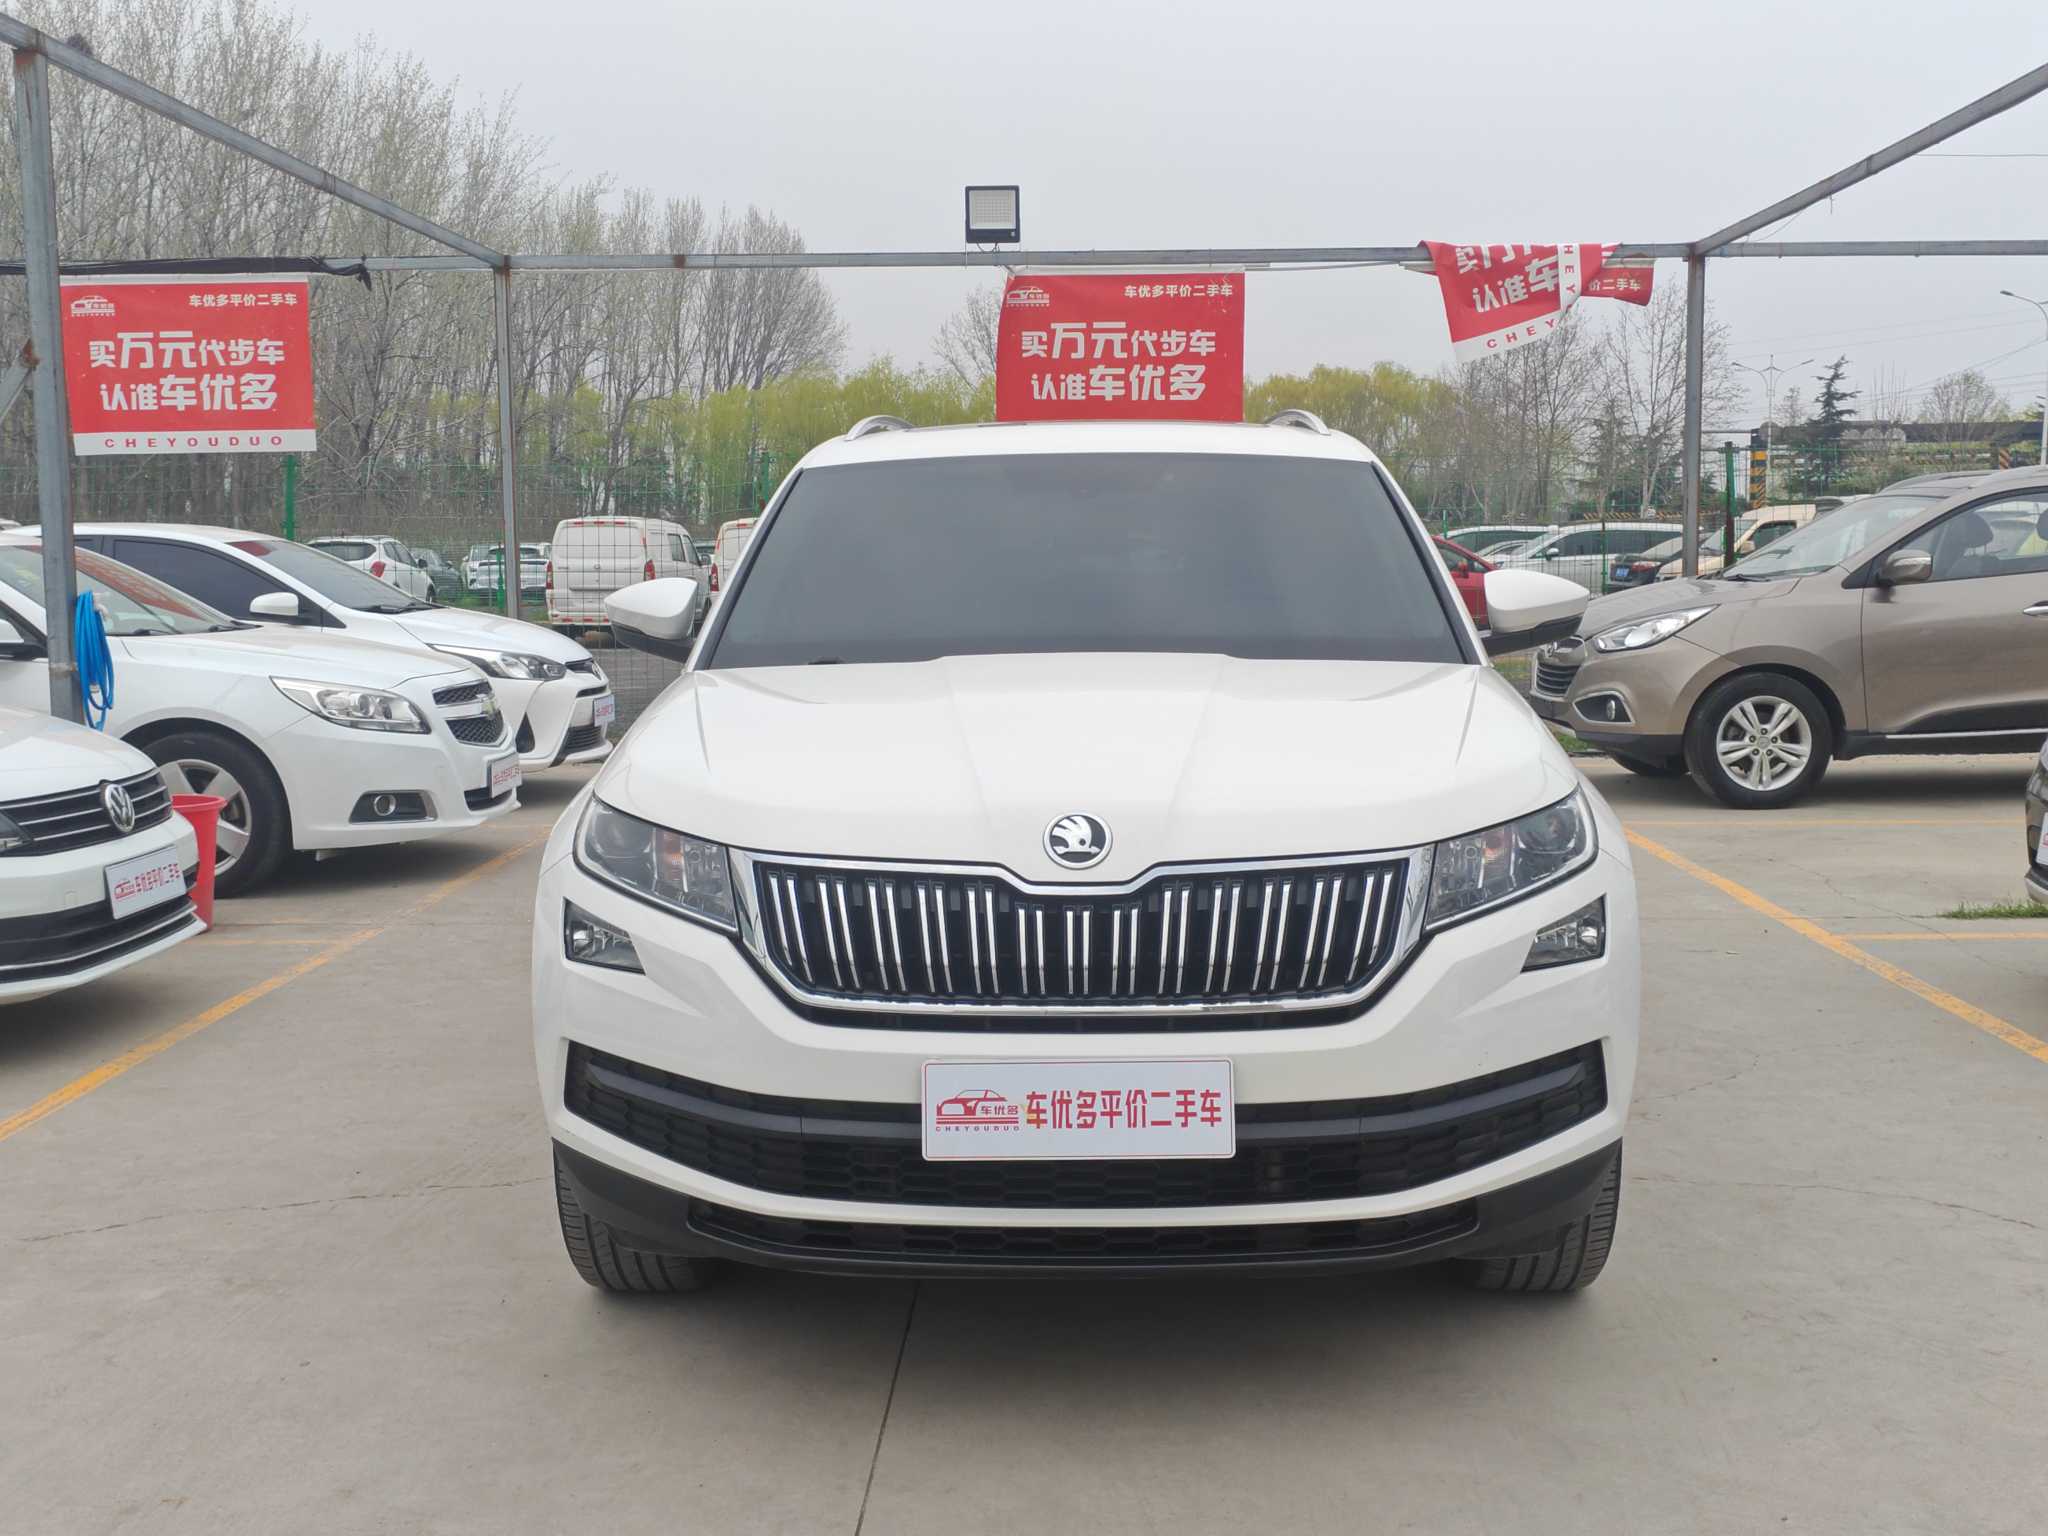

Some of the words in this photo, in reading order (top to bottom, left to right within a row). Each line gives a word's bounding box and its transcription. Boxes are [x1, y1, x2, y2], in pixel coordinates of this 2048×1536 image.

[190, 292, 297, 307] 车优多平价二手车
[1124, 283, 1233, 298] 车优多平价二手车
[1473, 255, 1559, 313] 认准车
[89, 330, 285, 369] 买万元代步车
[1021, 321, 1217, 360] 买万元代步车
[99, 373, 278, 412] 认准车优多
[1031, 363, 1206, 401] 认准车优多
[104, 436, 283, 449] CHEYOUDUO
[1025, 1088, 1223, 1130] 车优多平价二手车
